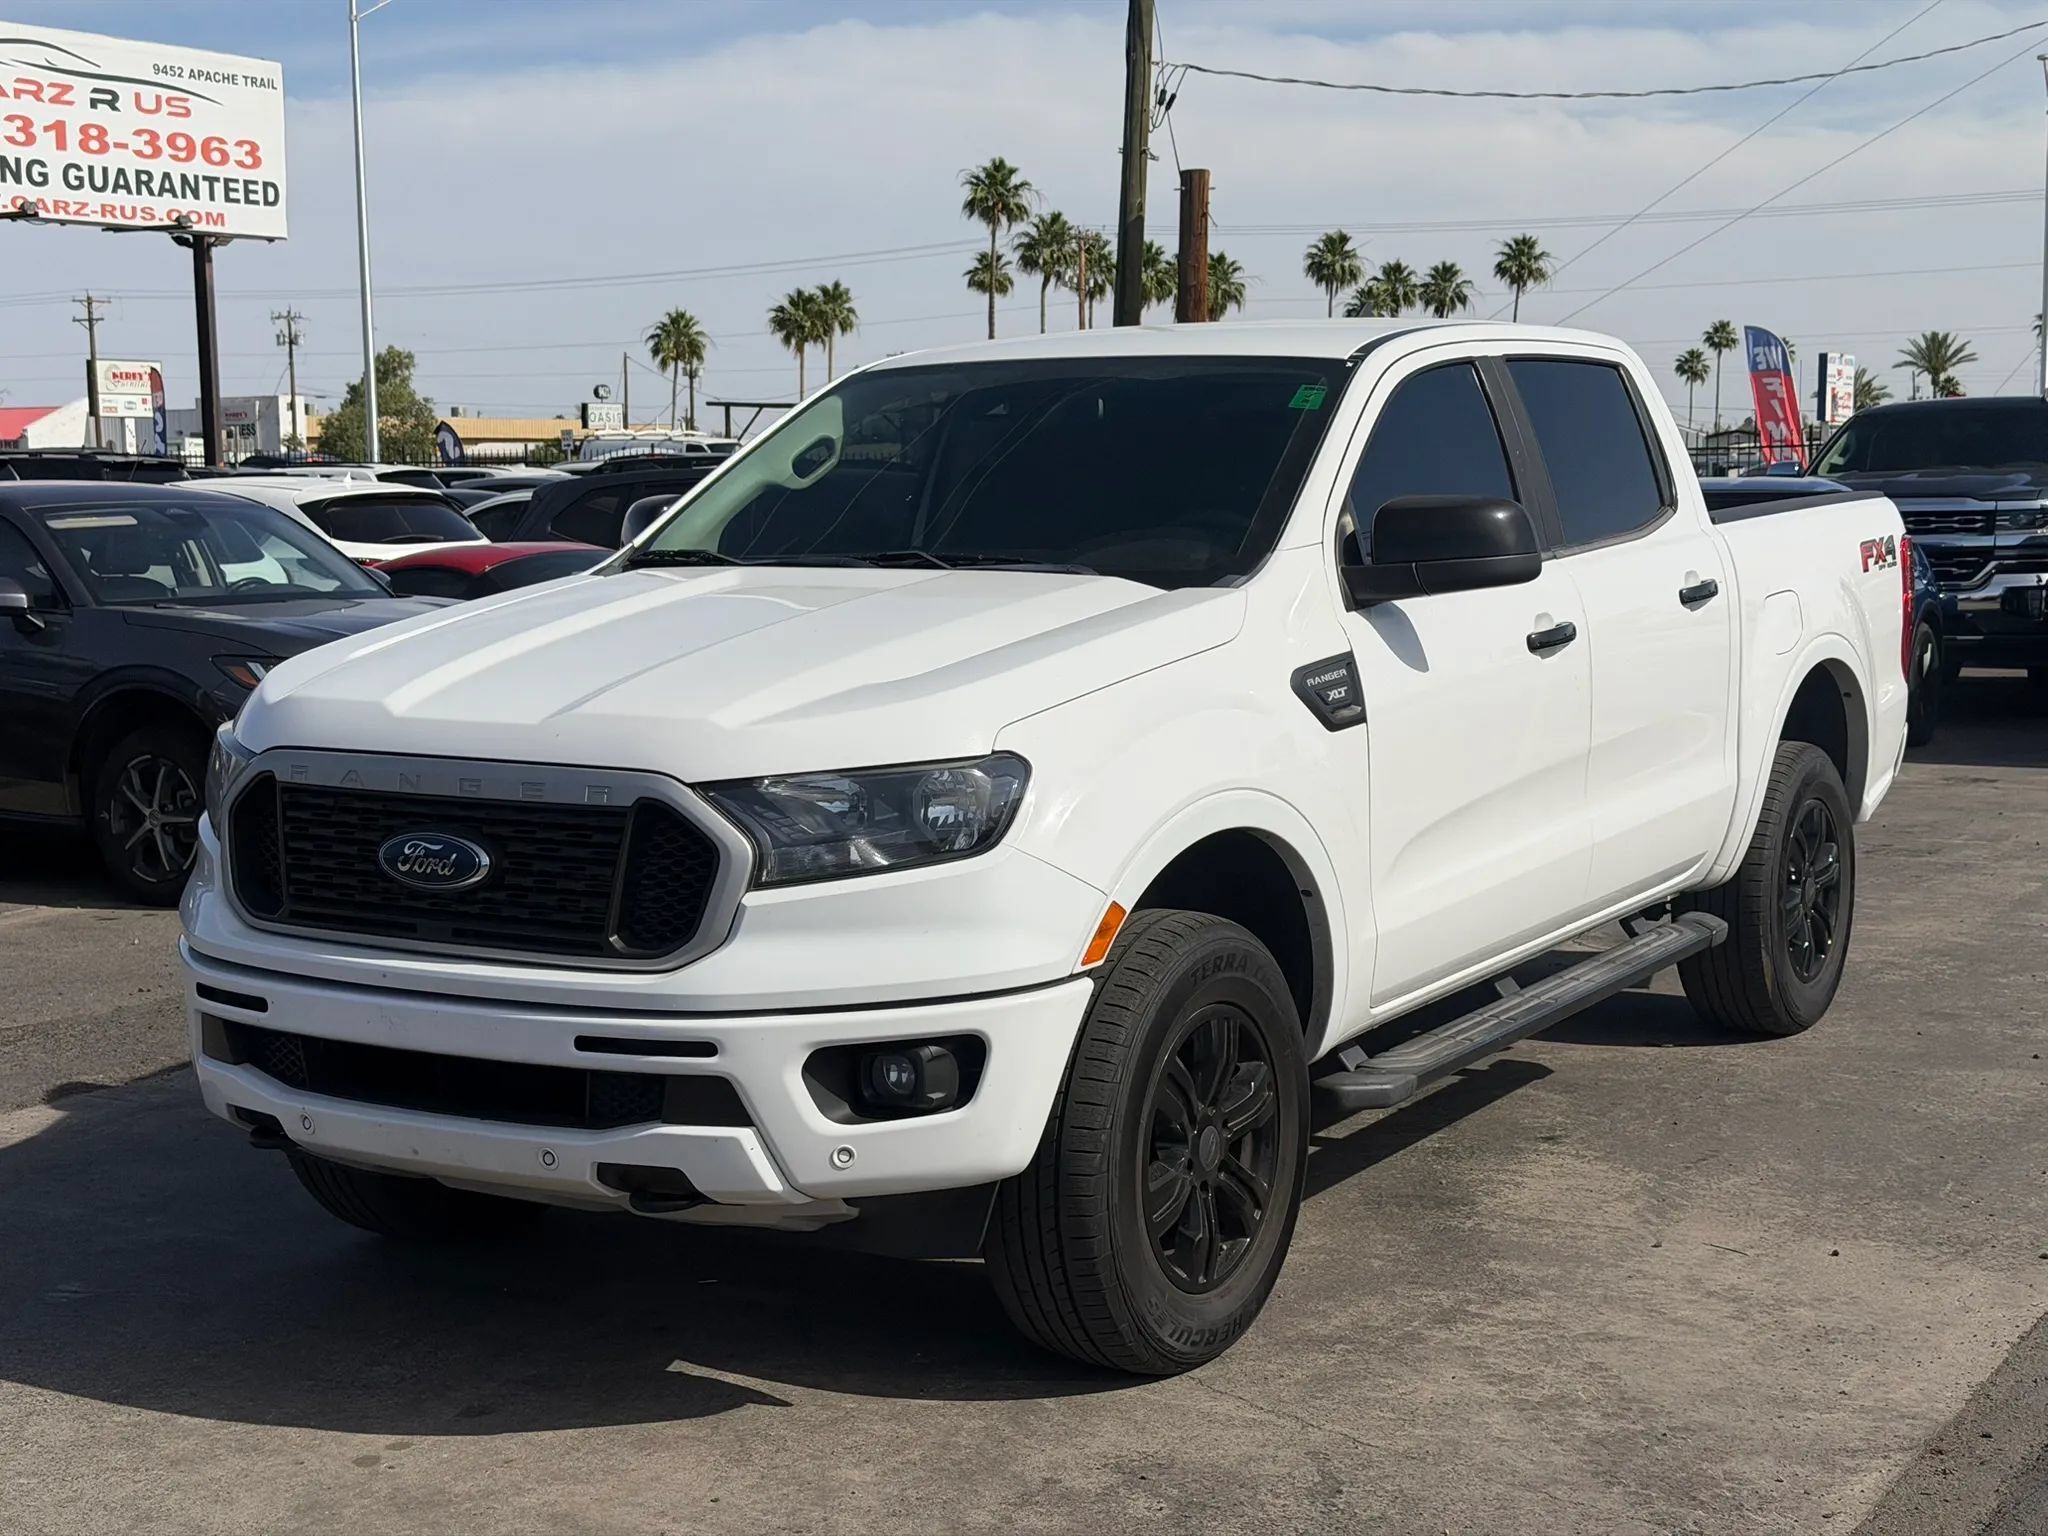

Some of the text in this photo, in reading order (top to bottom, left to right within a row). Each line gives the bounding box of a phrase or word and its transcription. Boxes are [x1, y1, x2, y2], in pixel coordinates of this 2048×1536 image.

[152, 63, 278, 91] 9452 APACHE TRAIL
[89, 87, 122, 113] R
[134, 92, 192, 119] US
[3, 114, 262, 170] 318-3963
[62, 162, 280, 208] GUARANTEED
[1860, 534, 1897, 573] FX4
[1306, 668, 1348, 687] RANGER
[1328, 687, 1347, 701] XLT
[289, 764, 613, 803] RANGER
[397, 840, 457, 876] Ford
[1189, 953, 1249, 987] TERRA
[1145, 1297, 1244, 1348] HERCULES
